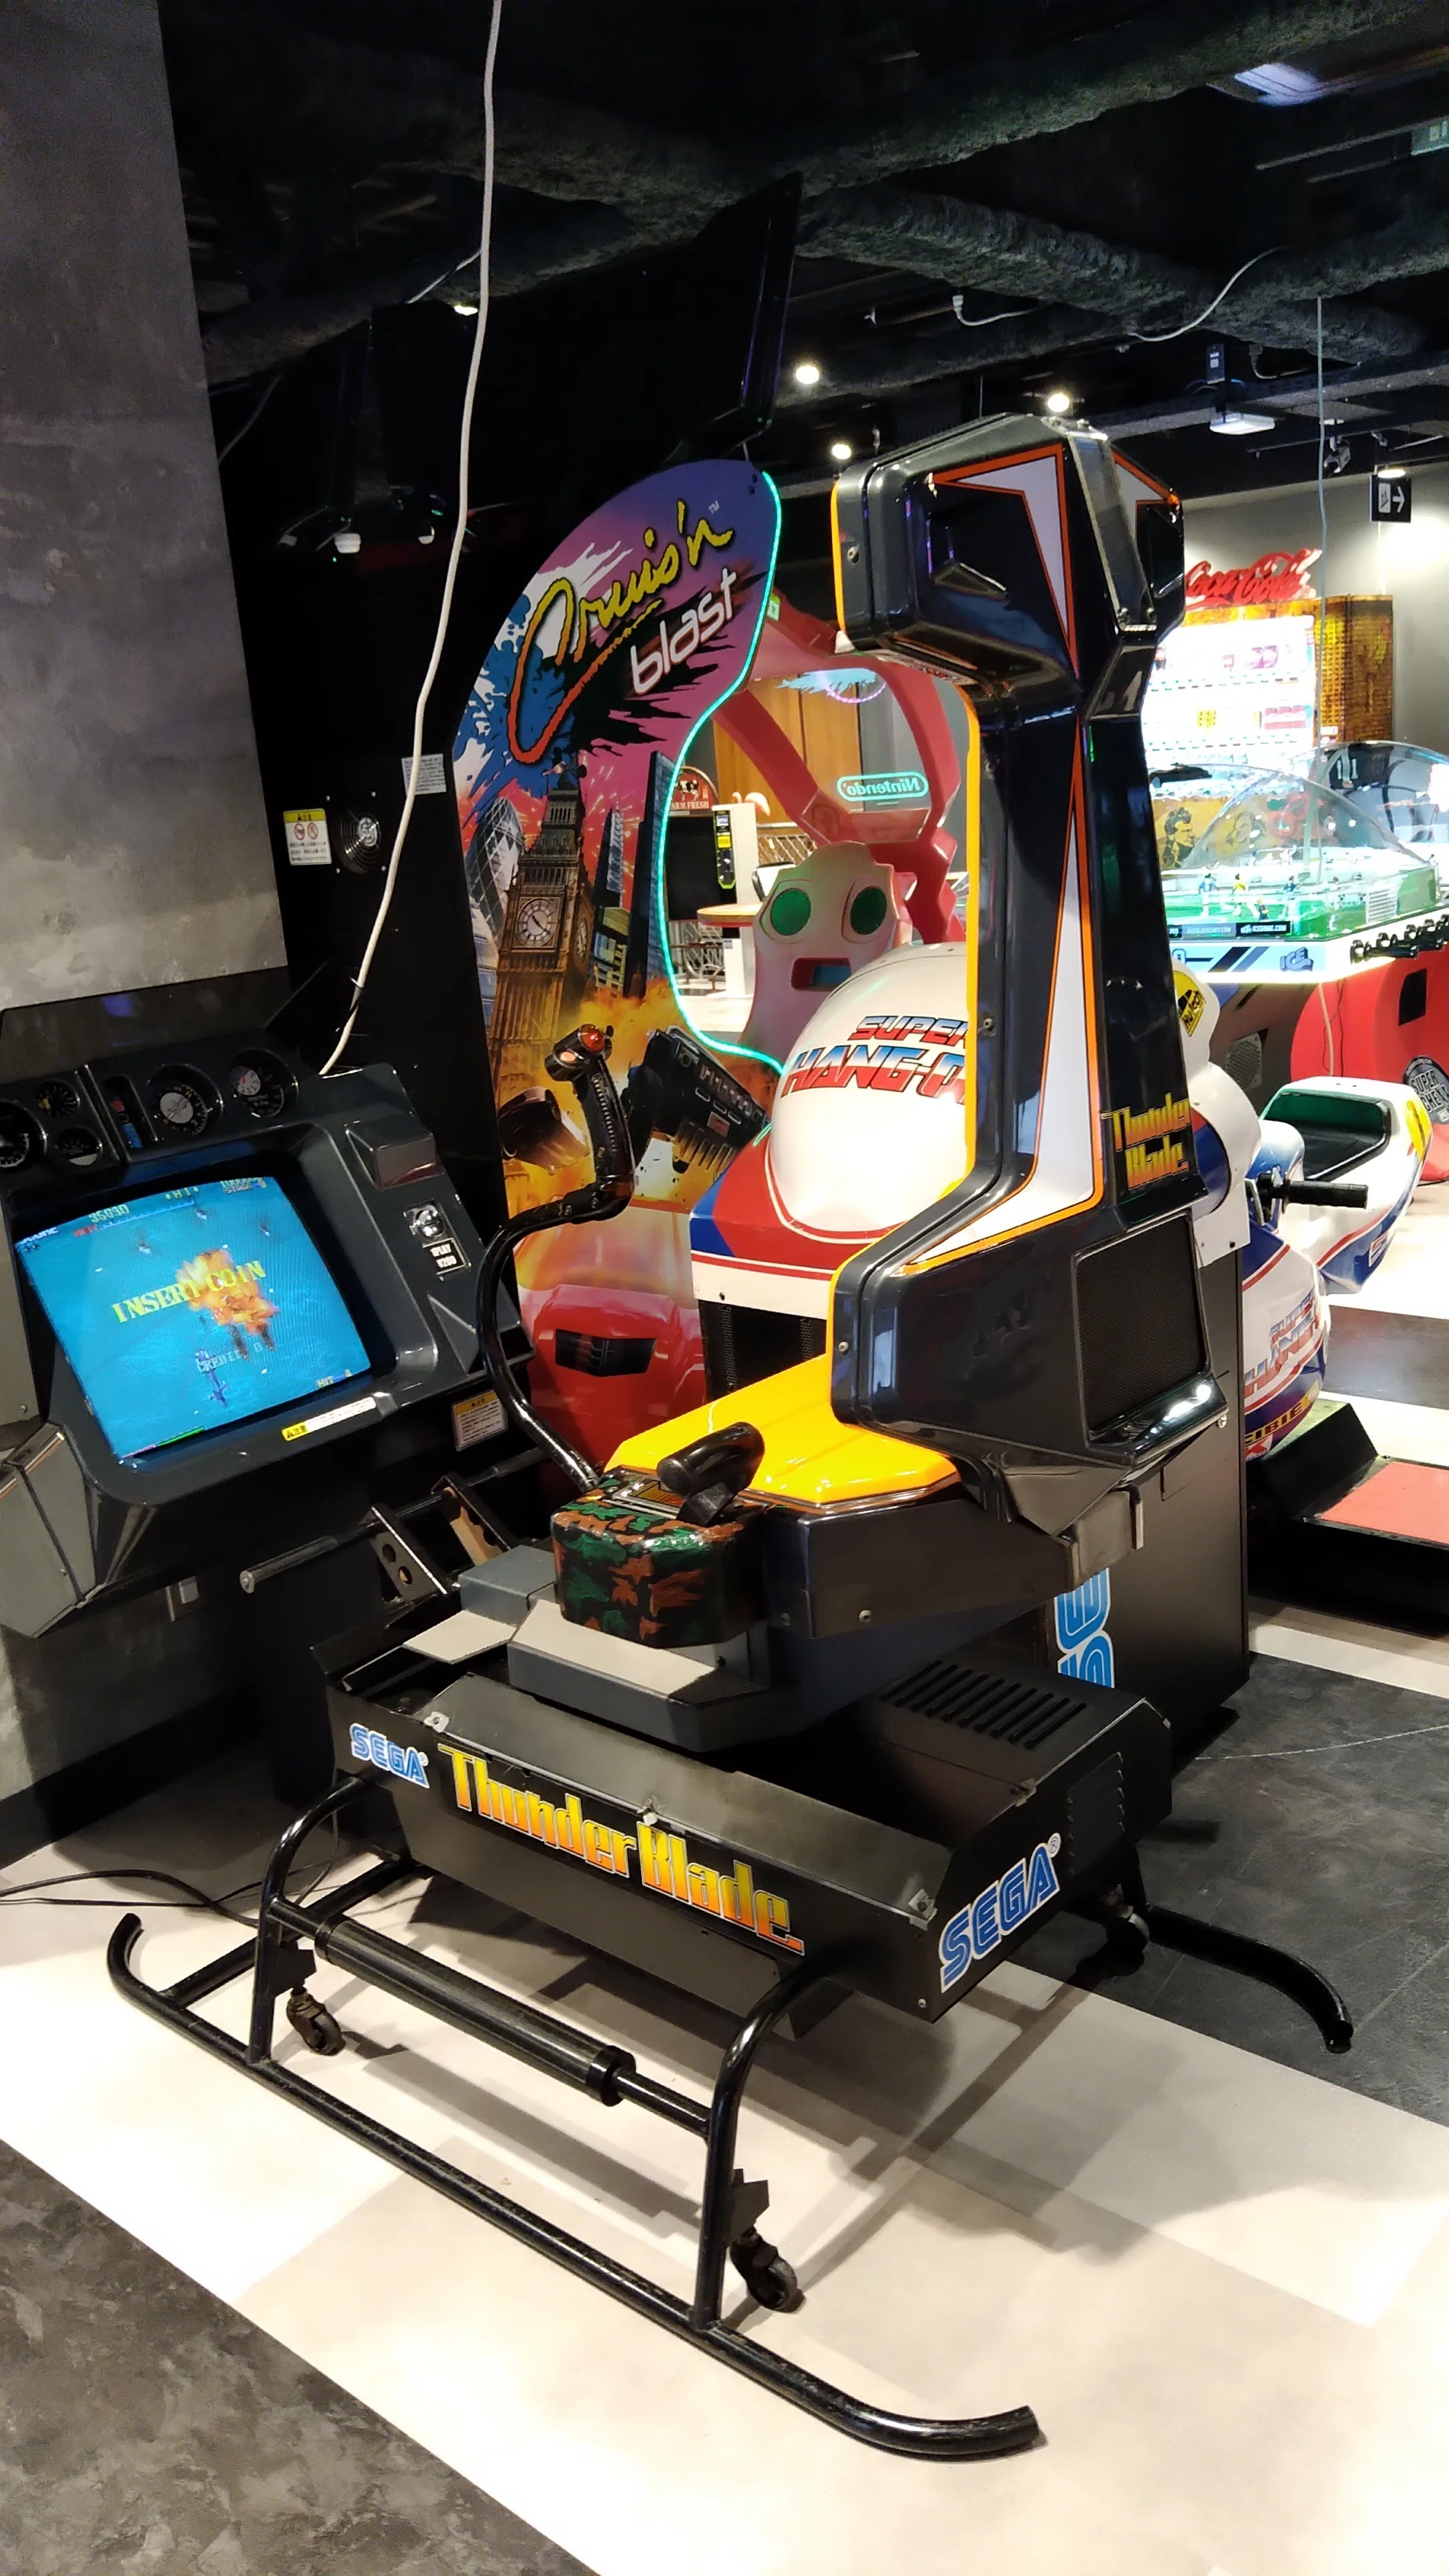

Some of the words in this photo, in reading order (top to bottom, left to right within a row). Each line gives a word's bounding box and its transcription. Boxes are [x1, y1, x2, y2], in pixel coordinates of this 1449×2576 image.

[509, 500, 733, 763] Cruis'n
[631, 568, 737, 695] blast
[670, 802, 686, 810] ARM
[1280, 947, 1313, 972] ICE
[781, 1044, 966, 1105] HANG-O
[1410, 1069, 1439, 1095] SUPER
[1124, 1134, 1189, 1191] Blade
[111, 1279, 201, 1323] INSERT
[205, 1260, 267, 1291] COIN
[349, 1722, 430, 1789] SEGA
[437, 1743, 637, 1878] Thunder
[636, 1820, 804, 1956] Blade
[939, 1841, 1061, 1993] SEGA
